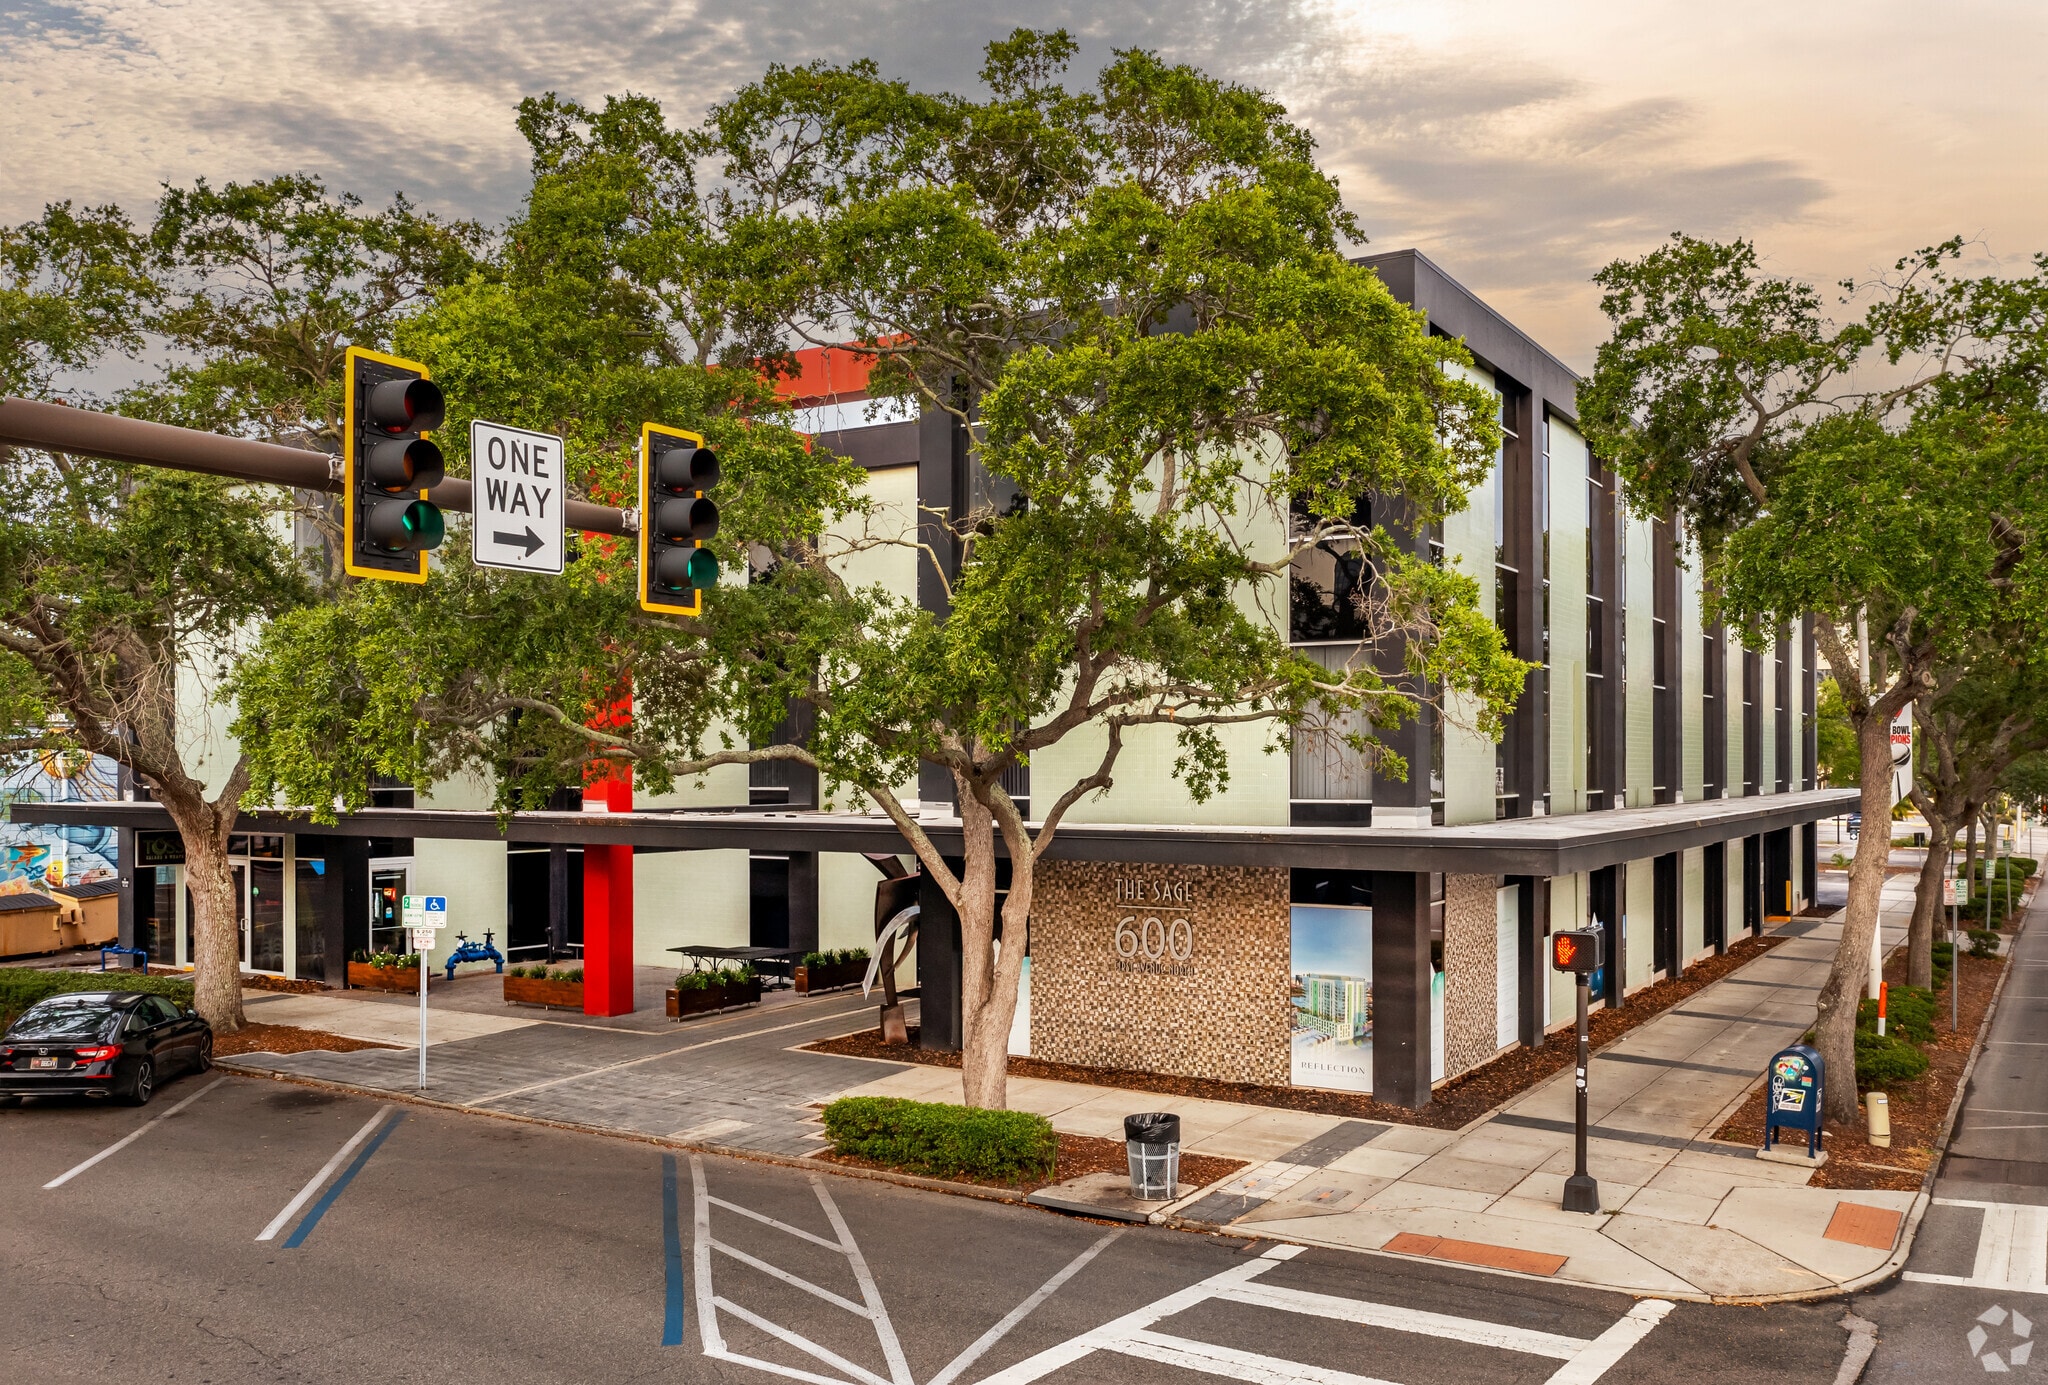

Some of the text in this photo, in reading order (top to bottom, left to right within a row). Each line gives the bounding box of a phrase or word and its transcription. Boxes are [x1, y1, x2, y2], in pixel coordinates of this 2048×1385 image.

[488, 437, 549, 479] ONE
[486, 477, 552, 519] WAY
[1892, 725, 1911, 735] BOWL
[1115, 878, 1193, 902] THE SAGE
[404, 898, 409, 907] 2
[1114, 915, 1193, 961] 600
[1301, 1061, 1366, 1075] REFLECTION
